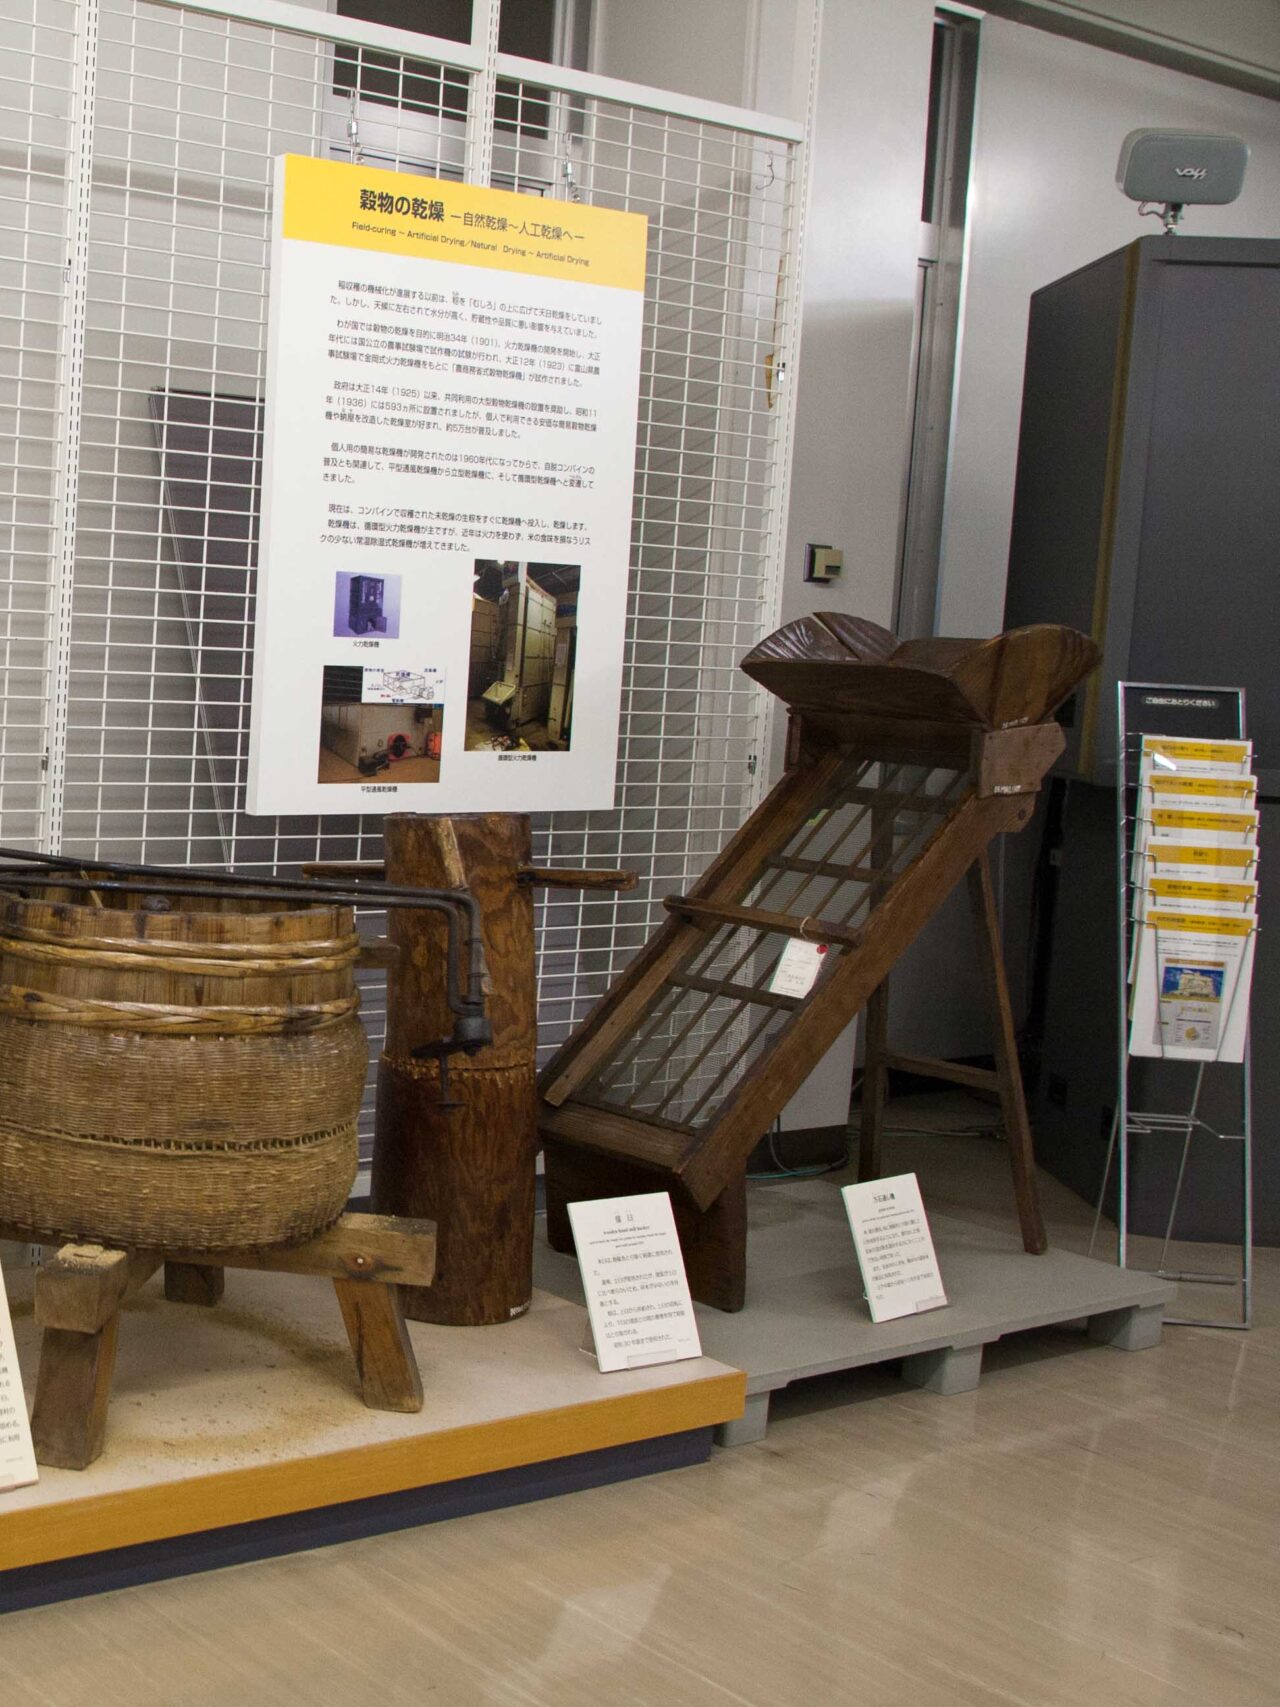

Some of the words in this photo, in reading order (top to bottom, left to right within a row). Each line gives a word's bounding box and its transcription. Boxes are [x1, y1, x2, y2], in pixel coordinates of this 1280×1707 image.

[359, 188, 445, 222] 穀物の乾燥
[351, 221, 397, 236] Field-curing
[407, 230, 439, 243] Artificial
[503, 244, 527, 257] Drying
[536, 250, 566, 262] Artificial
[567, 255, 590, 267] Drying
